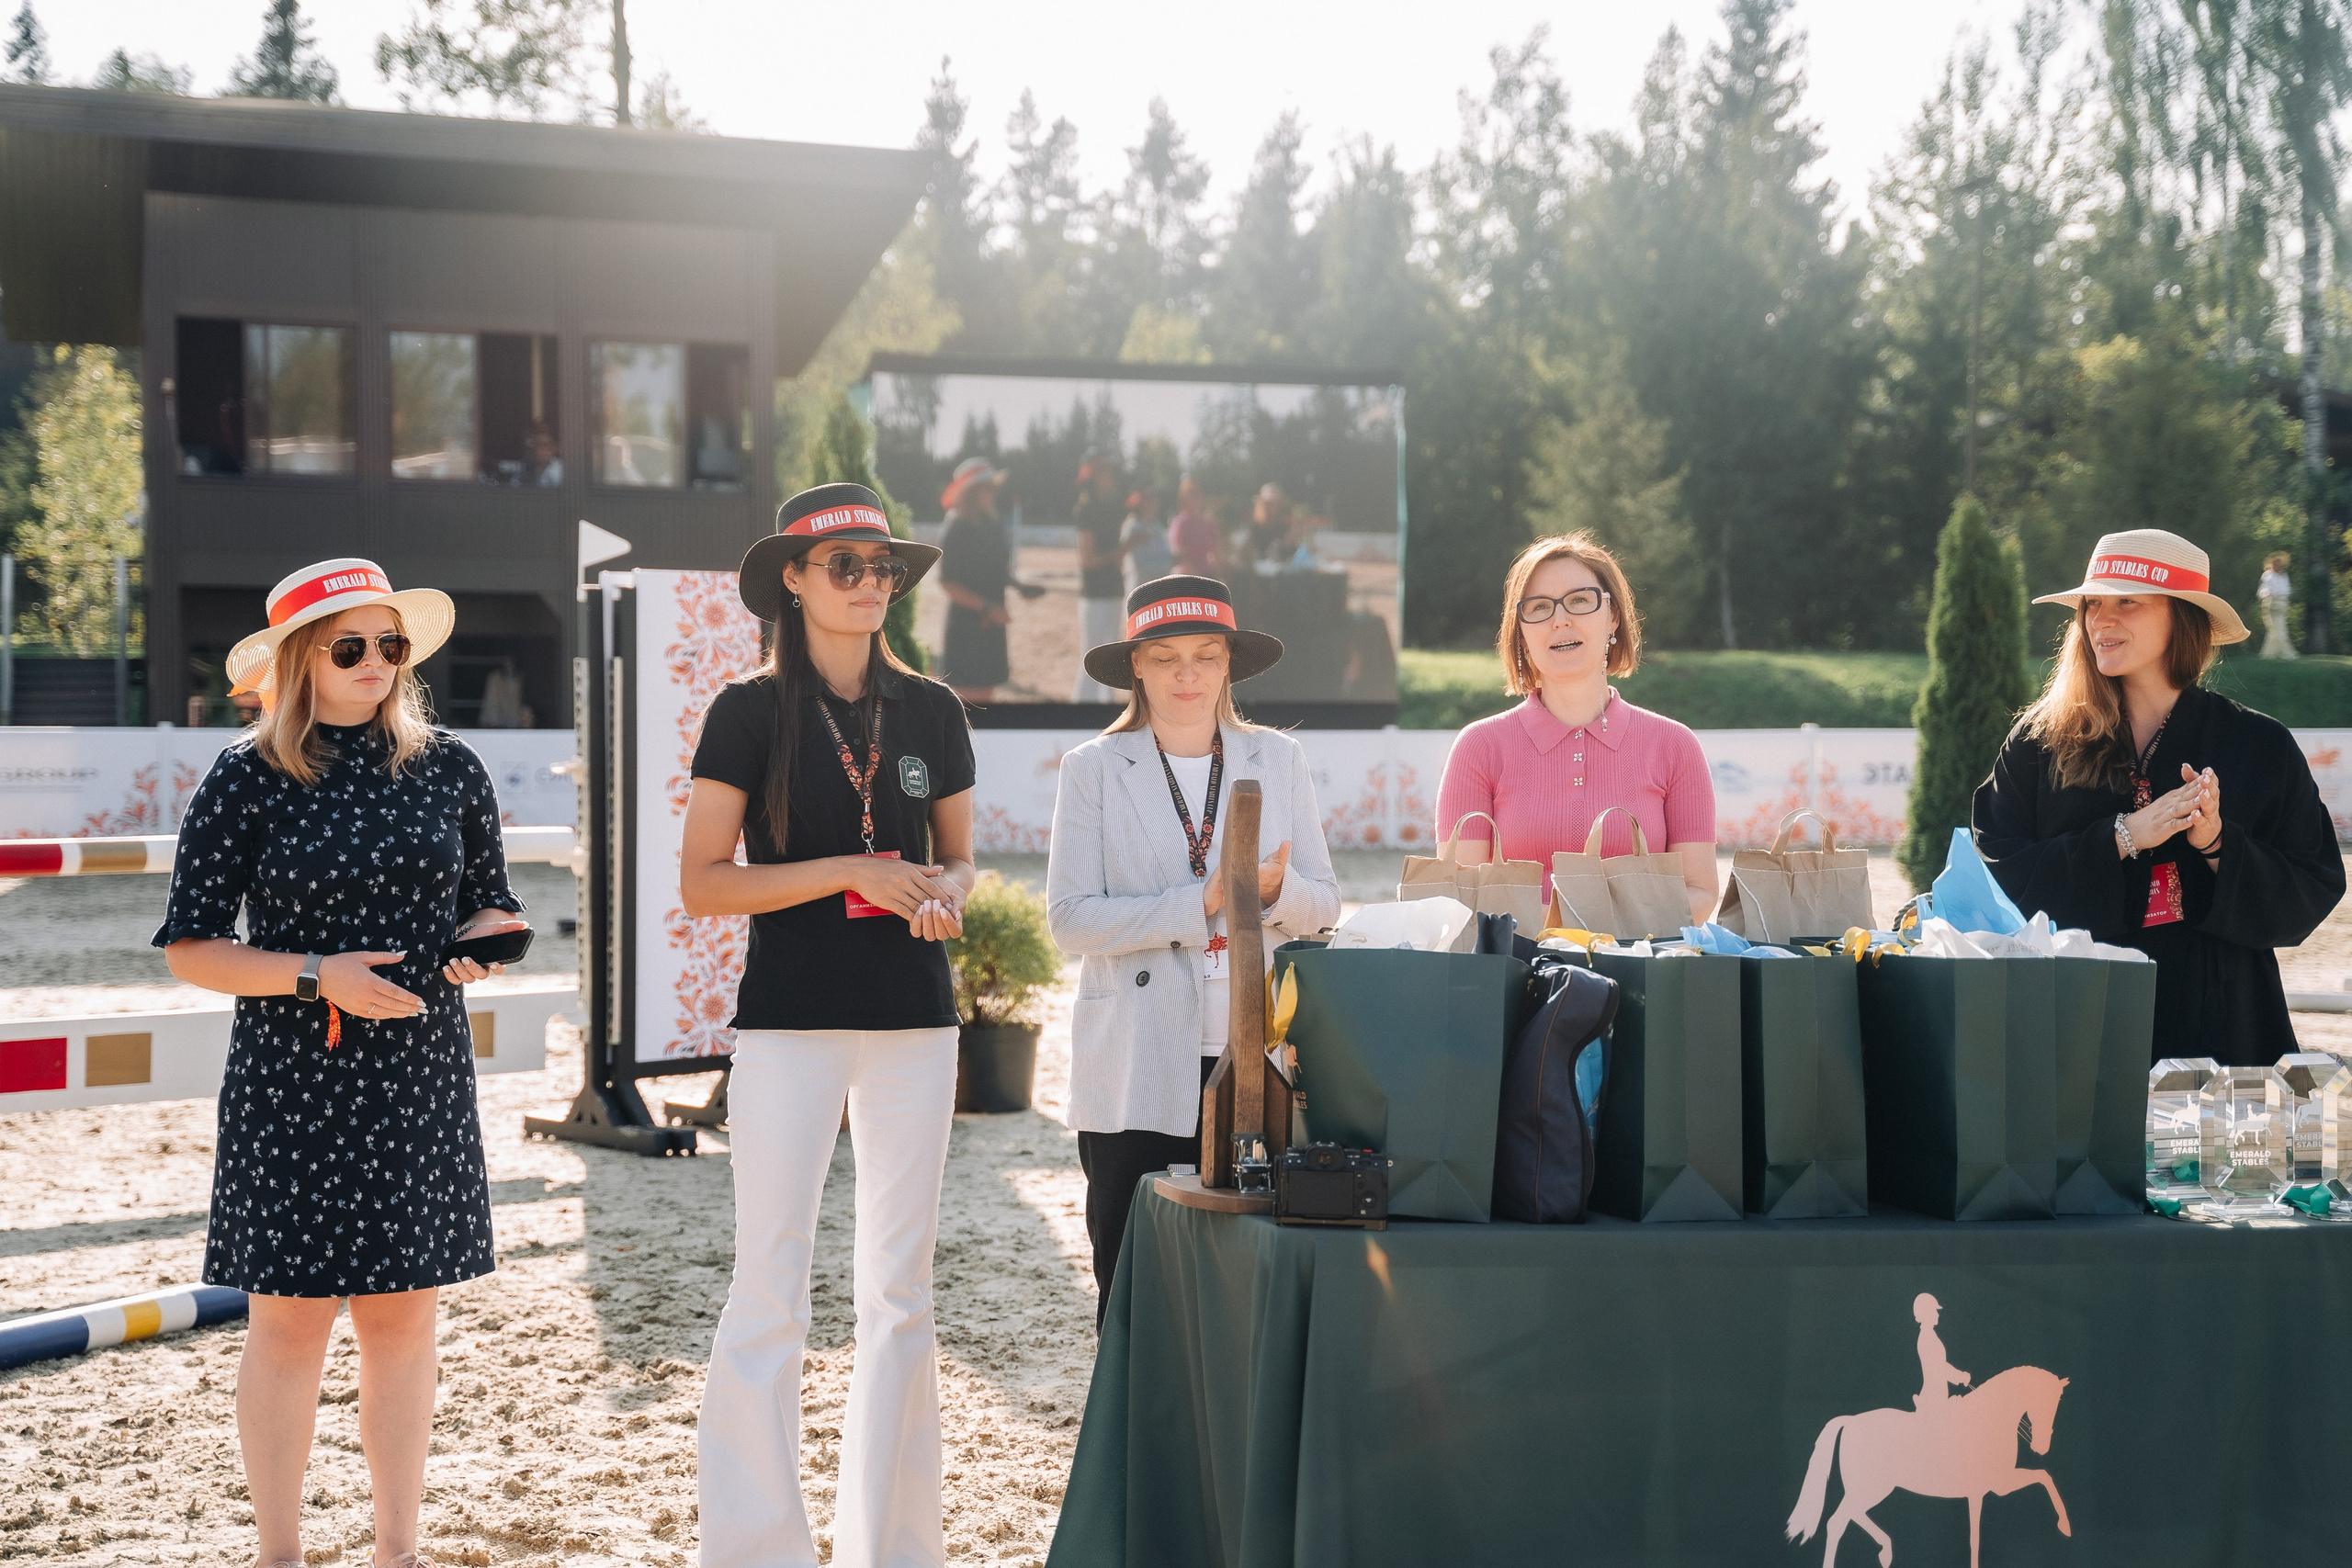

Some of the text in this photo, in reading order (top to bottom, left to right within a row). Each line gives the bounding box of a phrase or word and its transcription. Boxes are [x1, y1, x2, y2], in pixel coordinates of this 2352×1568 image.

[810, 510, 852, 533] EMERALD
[854, 509, 884, 527] STABLES
[2109, 560, 2149, 579] STABLES
[2151, 566, 2168, 583] CUP
[322, 572, 368, 593] EMERALD
[1135, 602, 1218, 630] EMERALD STABLES CUP
[2172, 1146, 2200, 1155] STABL
[2230, 1150, 2272, 1158] EMERALD
[2232, 1158, 2269, 1167] STABLES
